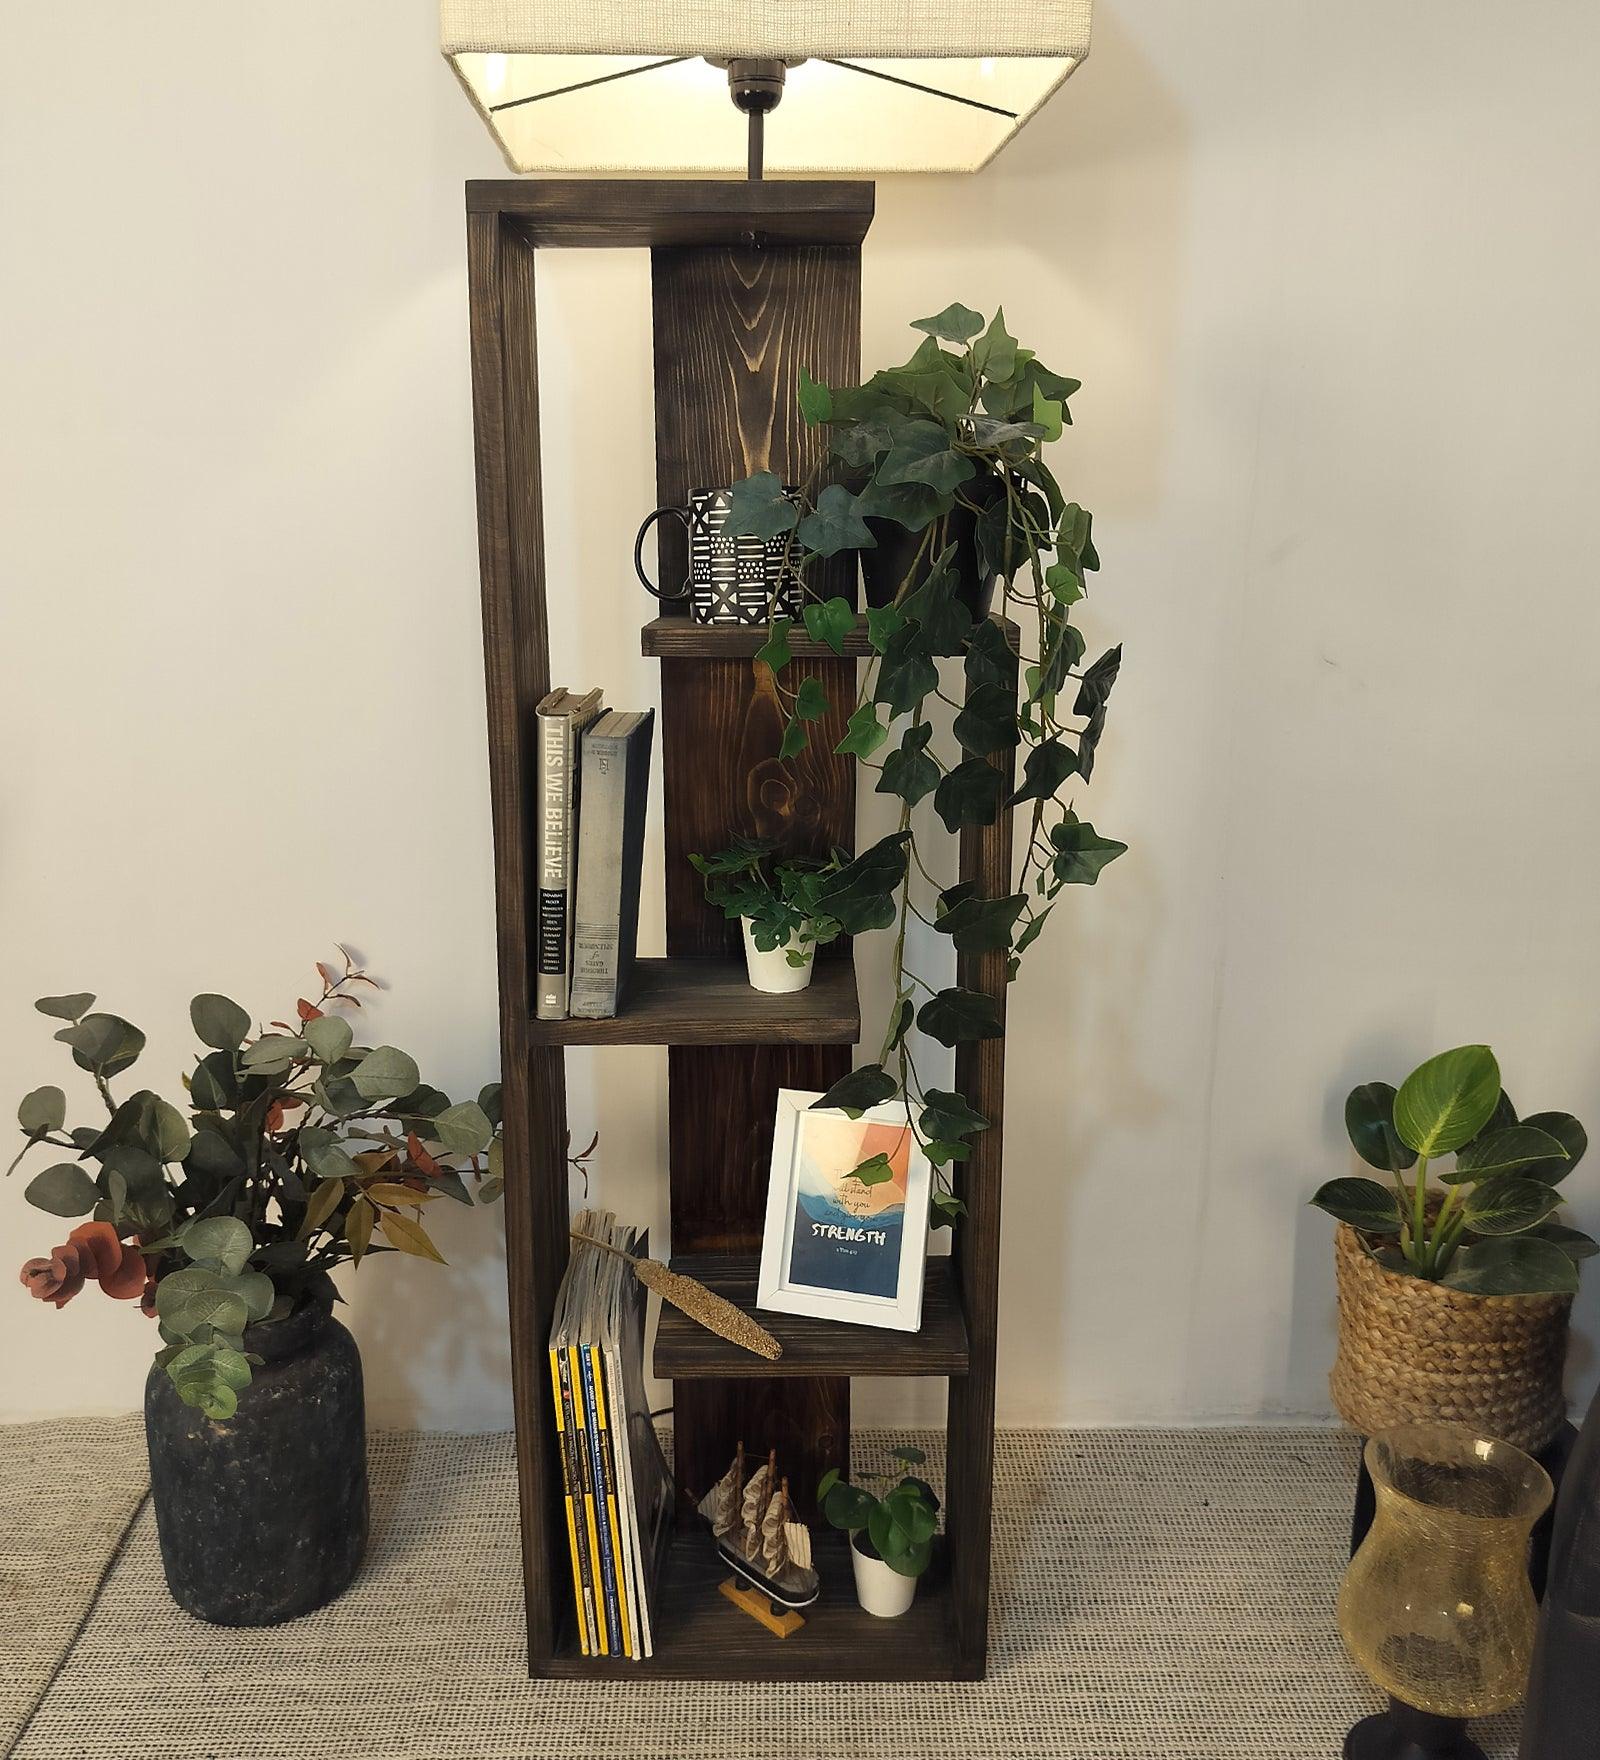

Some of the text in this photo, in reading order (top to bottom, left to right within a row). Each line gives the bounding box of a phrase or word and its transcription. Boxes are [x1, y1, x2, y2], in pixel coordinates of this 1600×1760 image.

[545, 725, 564, 767] THIS
[546, 772, 564, 802] WE
[545, 807, 563, 879] BELIEVE
[832, 1194, 871, 1213] with you
[811, 1223, 886, 1246] STRENGTH
